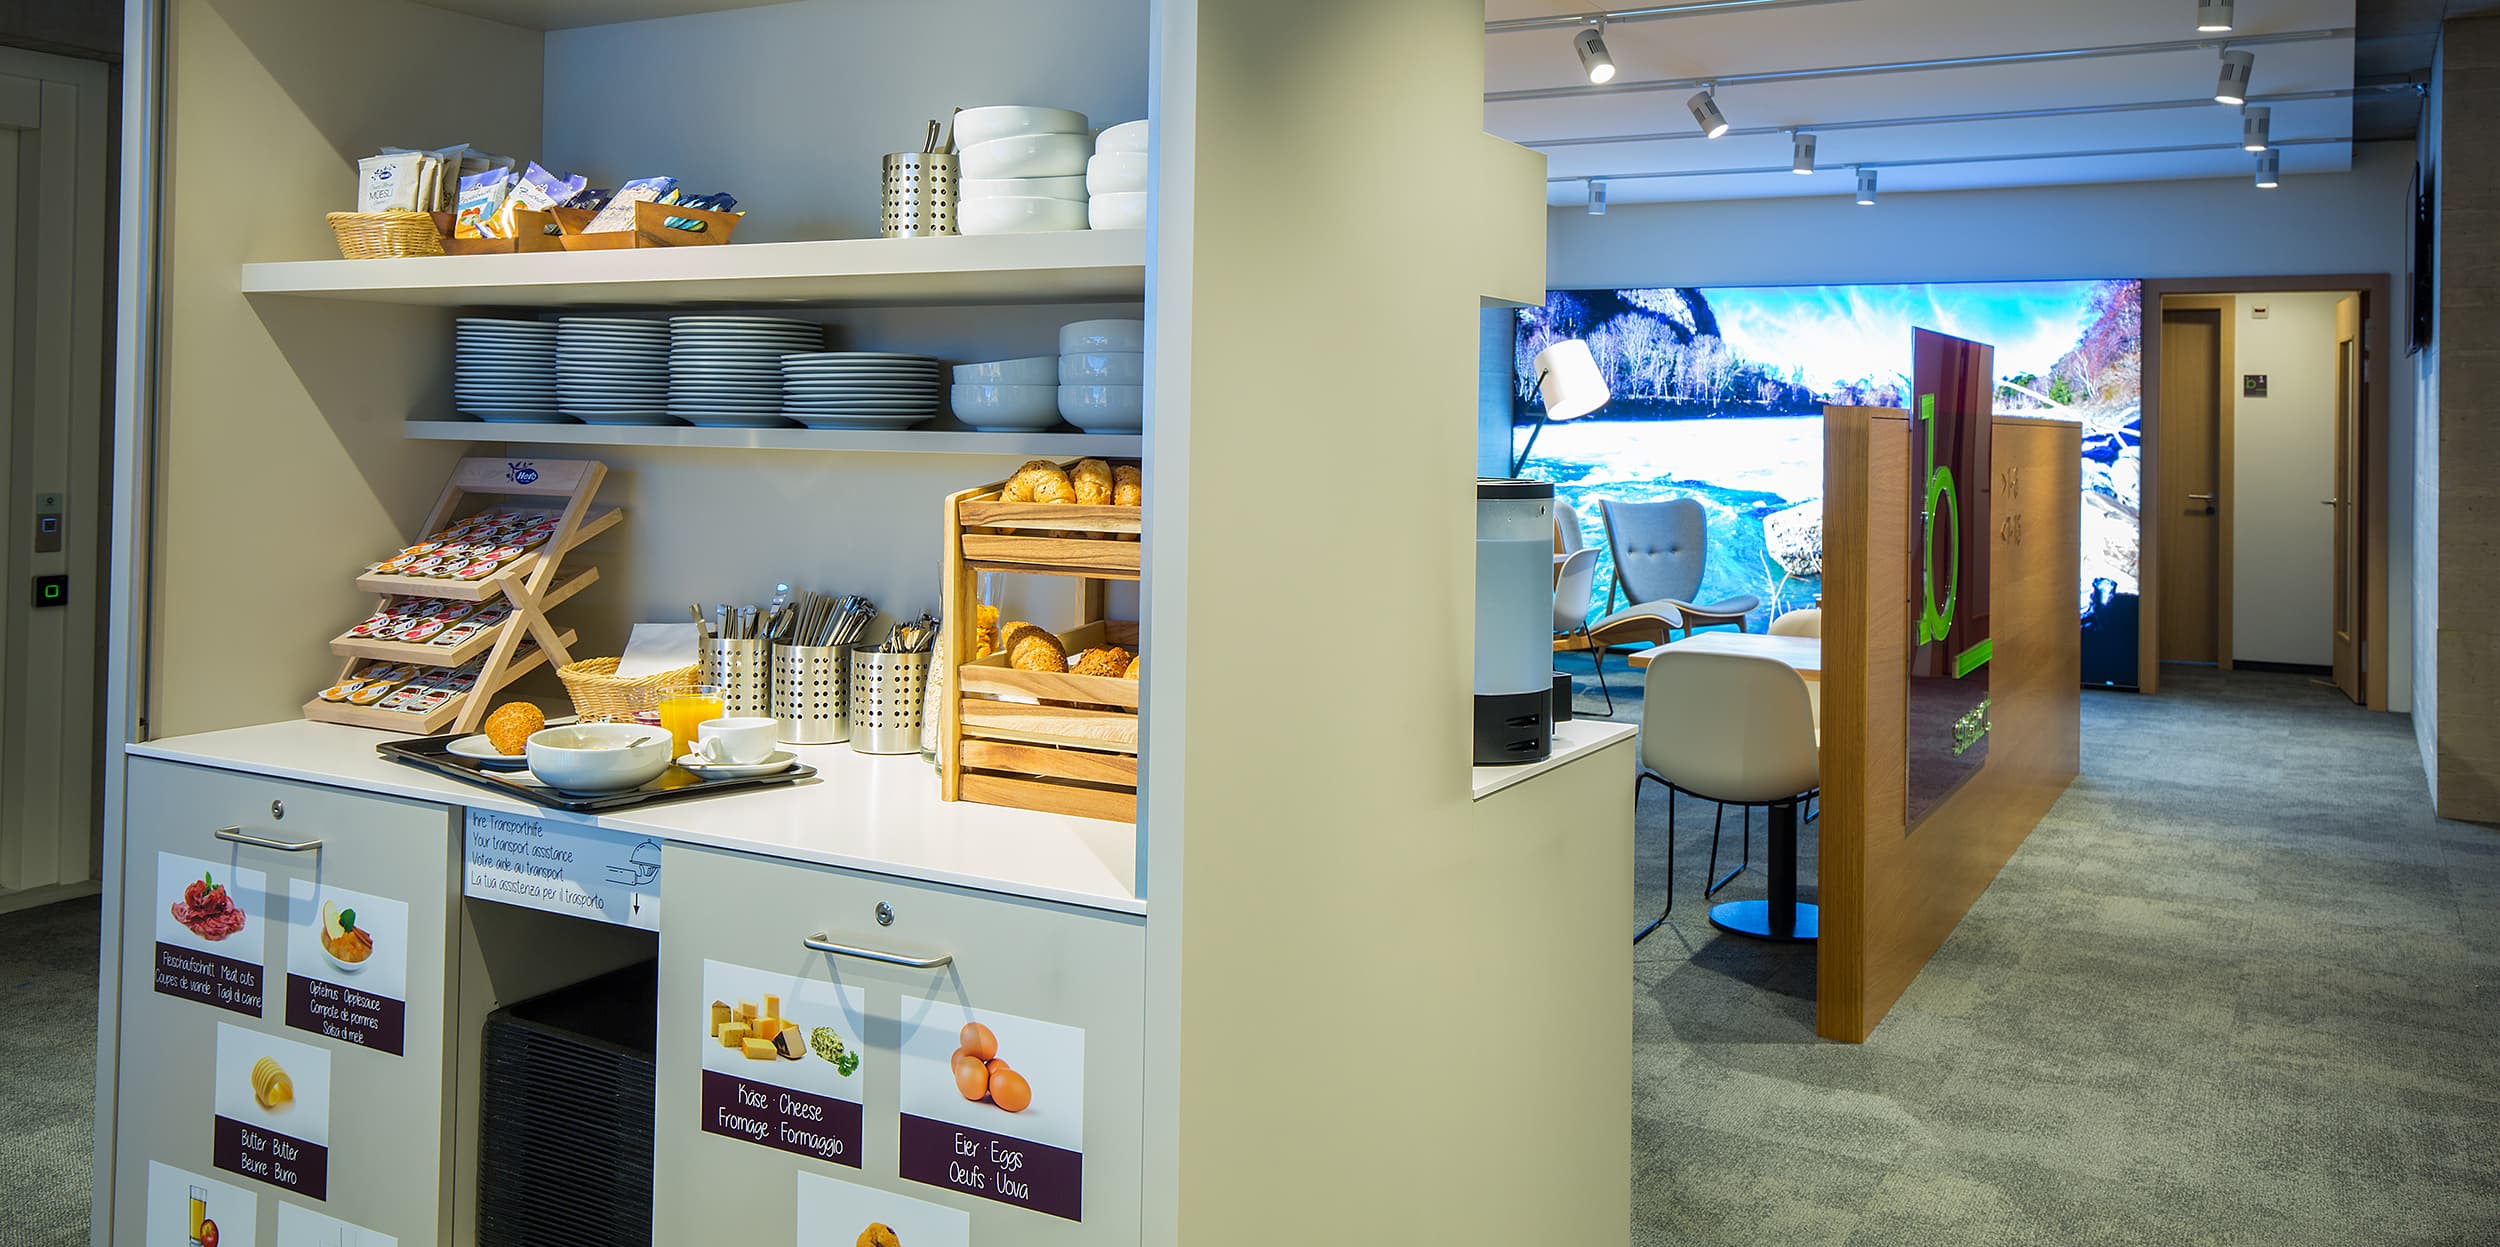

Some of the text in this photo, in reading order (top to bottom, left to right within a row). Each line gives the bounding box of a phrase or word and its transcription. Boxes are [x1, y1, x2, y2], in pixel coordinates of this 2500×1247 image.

[472, 831, 574, 863] Your transport assistance
[471, 850, 564, 881] Votre aide au transport
[471, 870, 482, 886] La
[484, 874, 497, 889] tua
[499, 879, 541, 897] assistenza
[542, 886, 557, 901] per
[565, 888, 605, 910] trasporto
[179, 975, 189, 990] de
[221, 965, 238, 983] Meat
[239, 971, 255, 987] cuts
[310, 998, 378, 1029] Compote de pommes
[348, 1030, 365, 1044] mele
[738, 1083, 824, 1122] Käse Cheese
[241, 1129, 300, 1161] Butter Butter
[719, 1107, 844, 1158] Fromage Formaggio
[955, 1132, 1024, 1172] Eier Eggs
[241, 1152, 298, 1185] Beurre Burro
[949, 1160, 1030, 1200] Oeufs Uova
